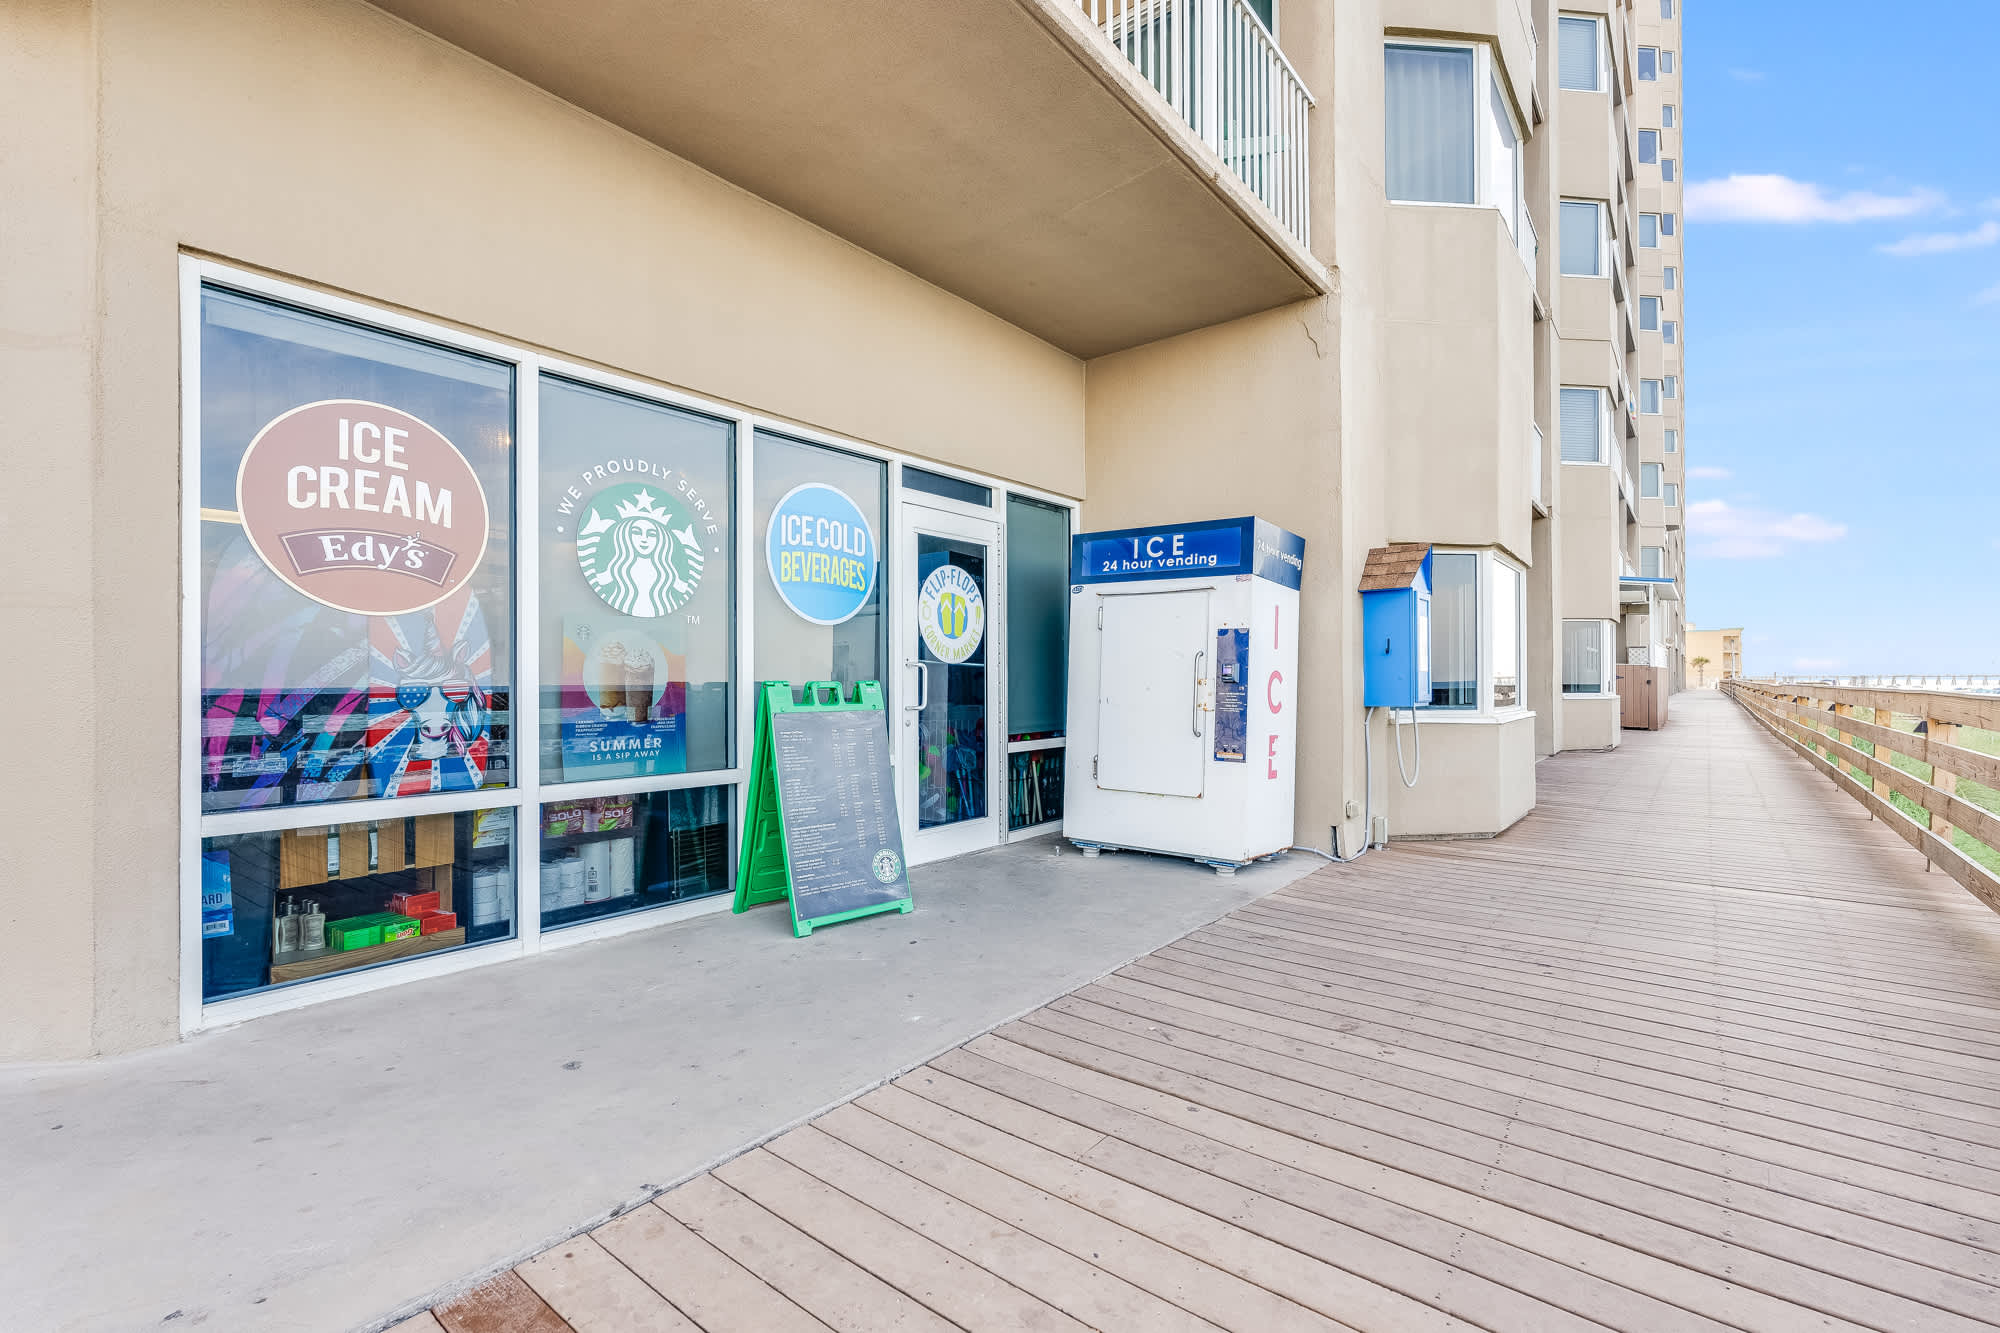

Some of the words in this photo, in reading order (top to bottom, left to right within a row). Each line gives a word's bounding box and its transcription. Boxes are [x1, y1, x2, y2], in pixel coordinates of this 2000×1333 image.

[338, 418, 409, 470] ICE
[287, 465, 452, 529] CREAM
[557, 485, 583, 516] WE
[582, 458, 672, 486] PROUDLY
[676, 479, 719, 536] SERVE
[781, 514, 814, 547] ICE
[816, 517, 866, 557] COLD
[1133, 534, 1185, 559] ICE
[781, 551, 866, 592] BEVERAGES
[1102, 560, 1118, 572] 24
[1122, 558, 1152, 571] hour
[1158, 553, 1217, 568] vending
[1280, 551, 1302, 571] vending
[924, 568, 980, 603] FLIP-FLOPS
[924, 625, 950, 659] CORNER
[953, 629, 980, 660] MARKET
[590, 737, 662, 752] SUMMER
[615, 752, 630, 760] SIP
[634, 750, 660, 758] AWAY
[549, 808, 582, 822] SOLO
